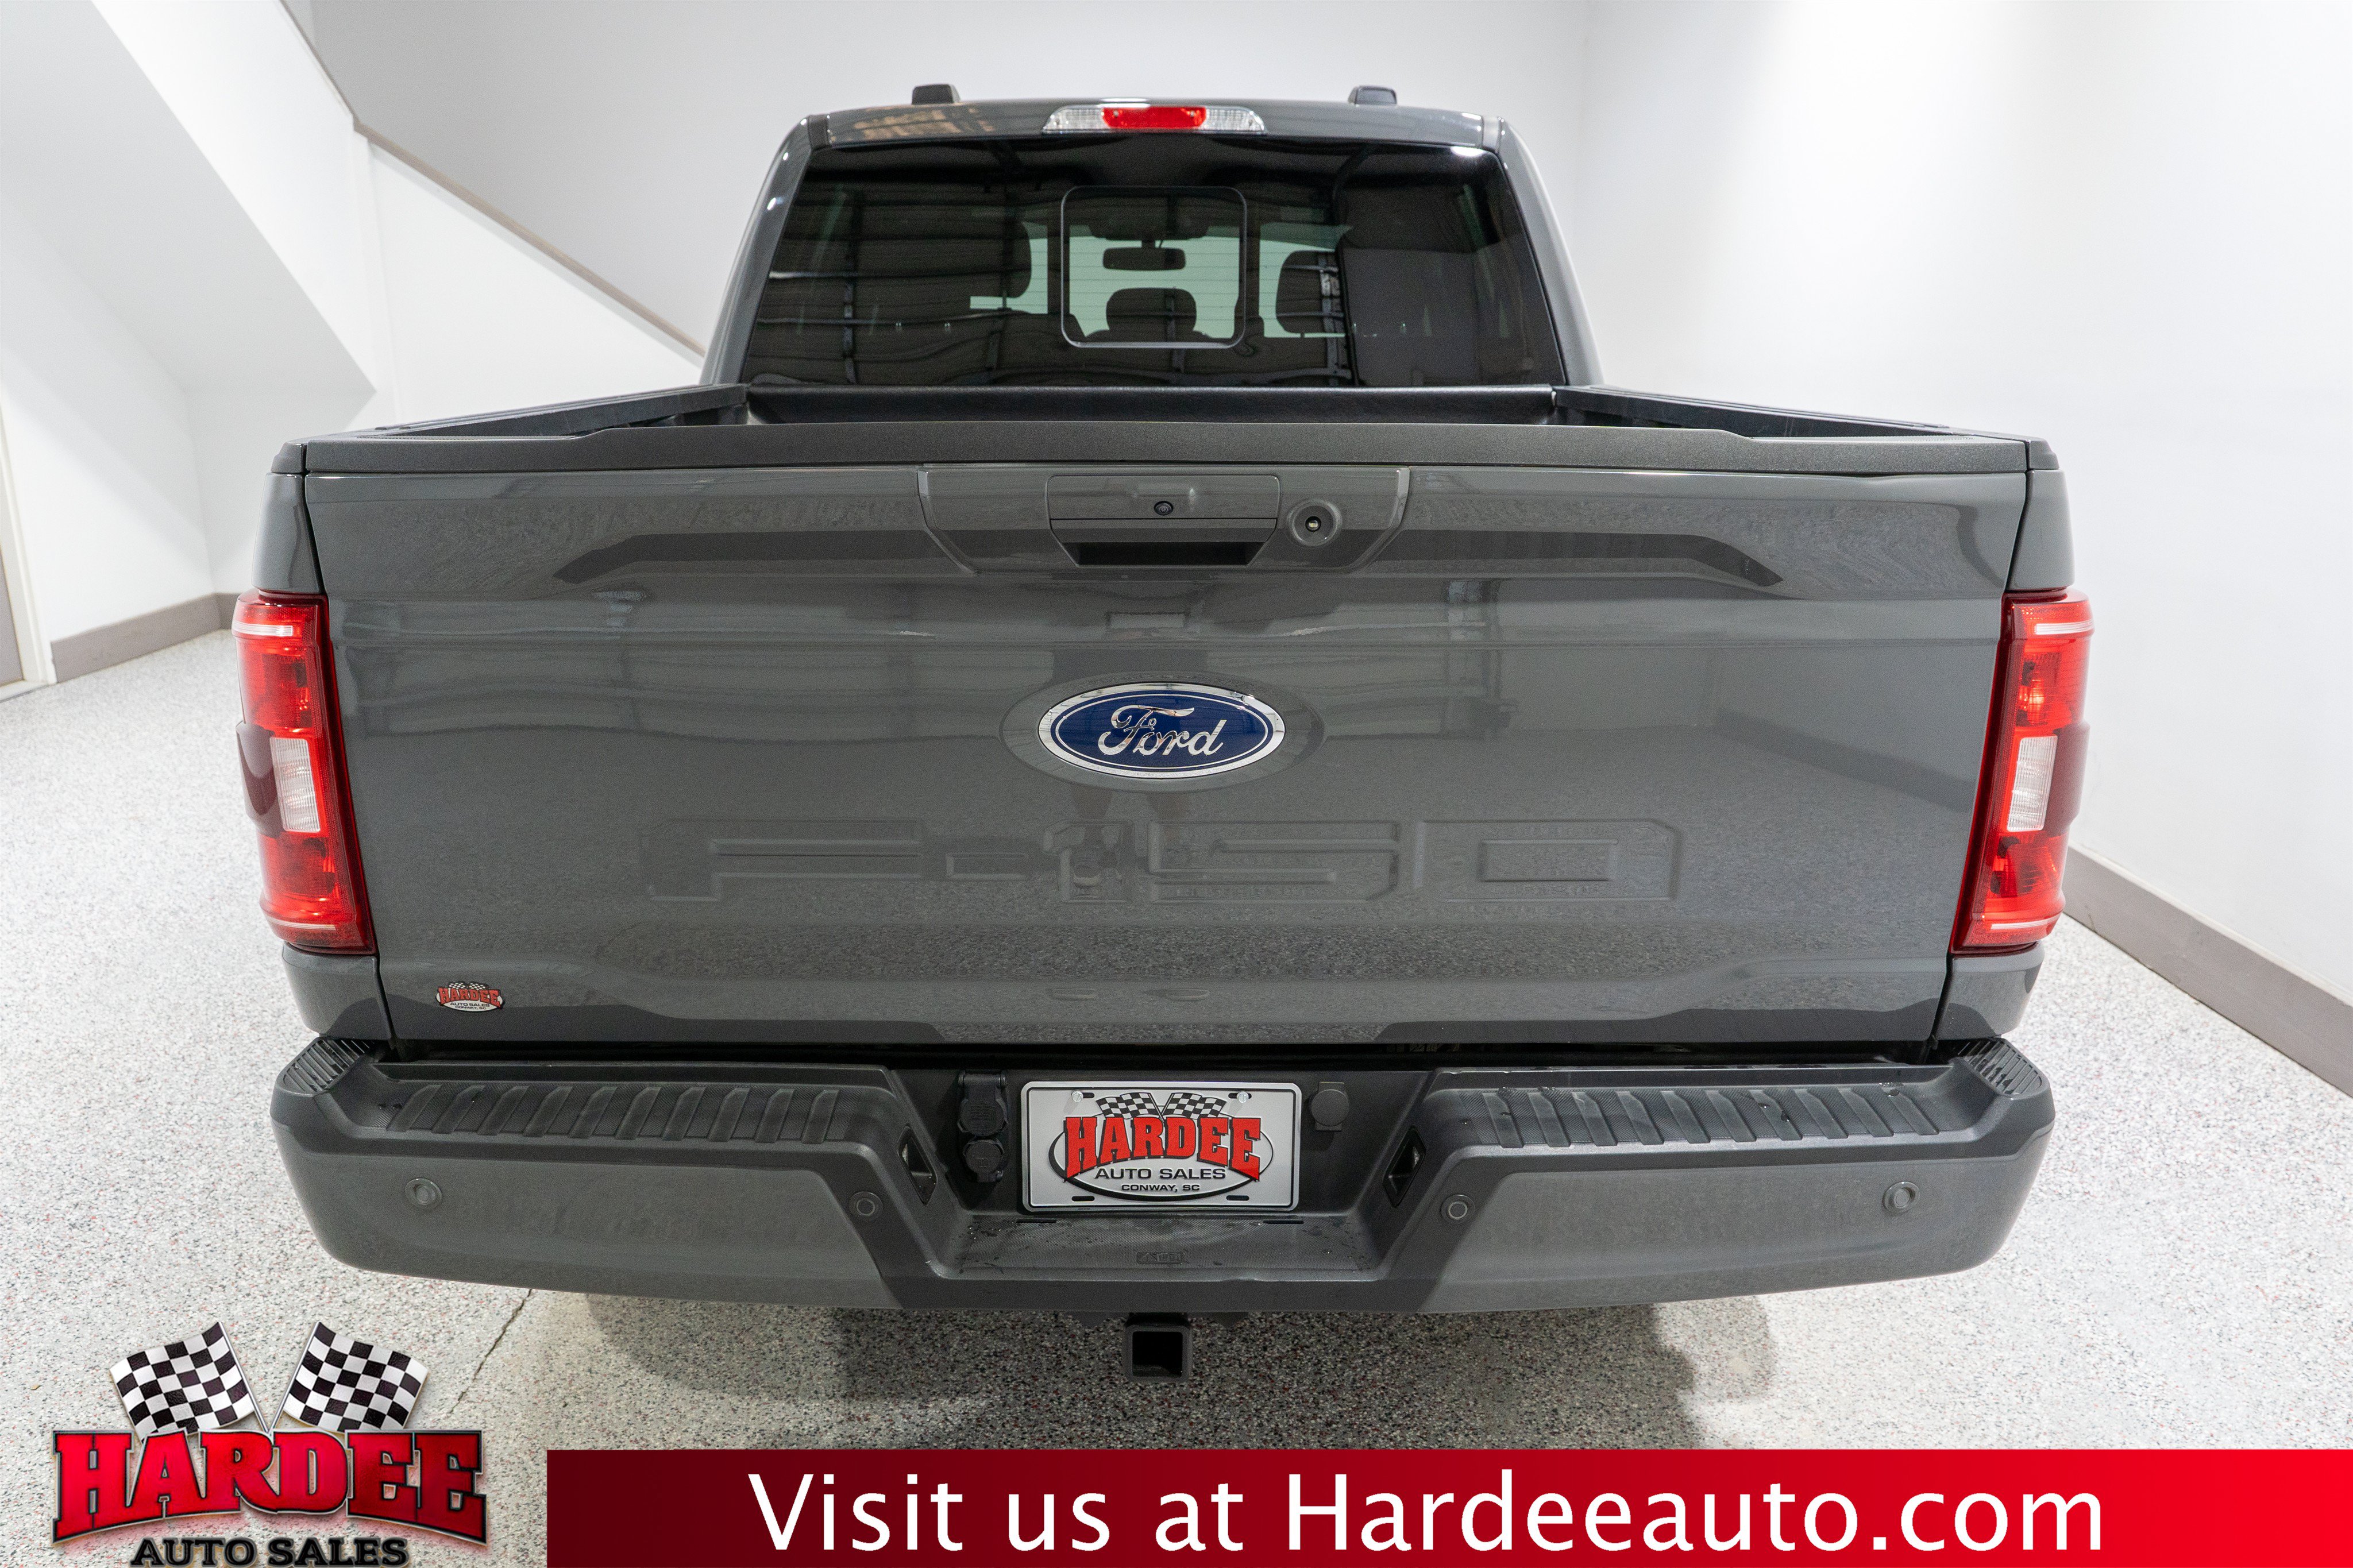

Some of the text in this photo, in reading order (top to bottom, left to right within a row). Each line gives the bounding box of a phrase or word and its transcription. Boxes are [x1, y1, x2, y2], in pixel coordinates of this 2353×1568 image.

[1098, 705, 1227, 756] Ford
[638, 818, 1682, 905] F-150
[438, 987, 502, 1008] HARDEE
[1063, 1116, 1262, 1183] HARDEE
[1094, 1168, 1226, 1180] AUTO SALES
[1121, 1184, 1178, 1192] CONWAY,
